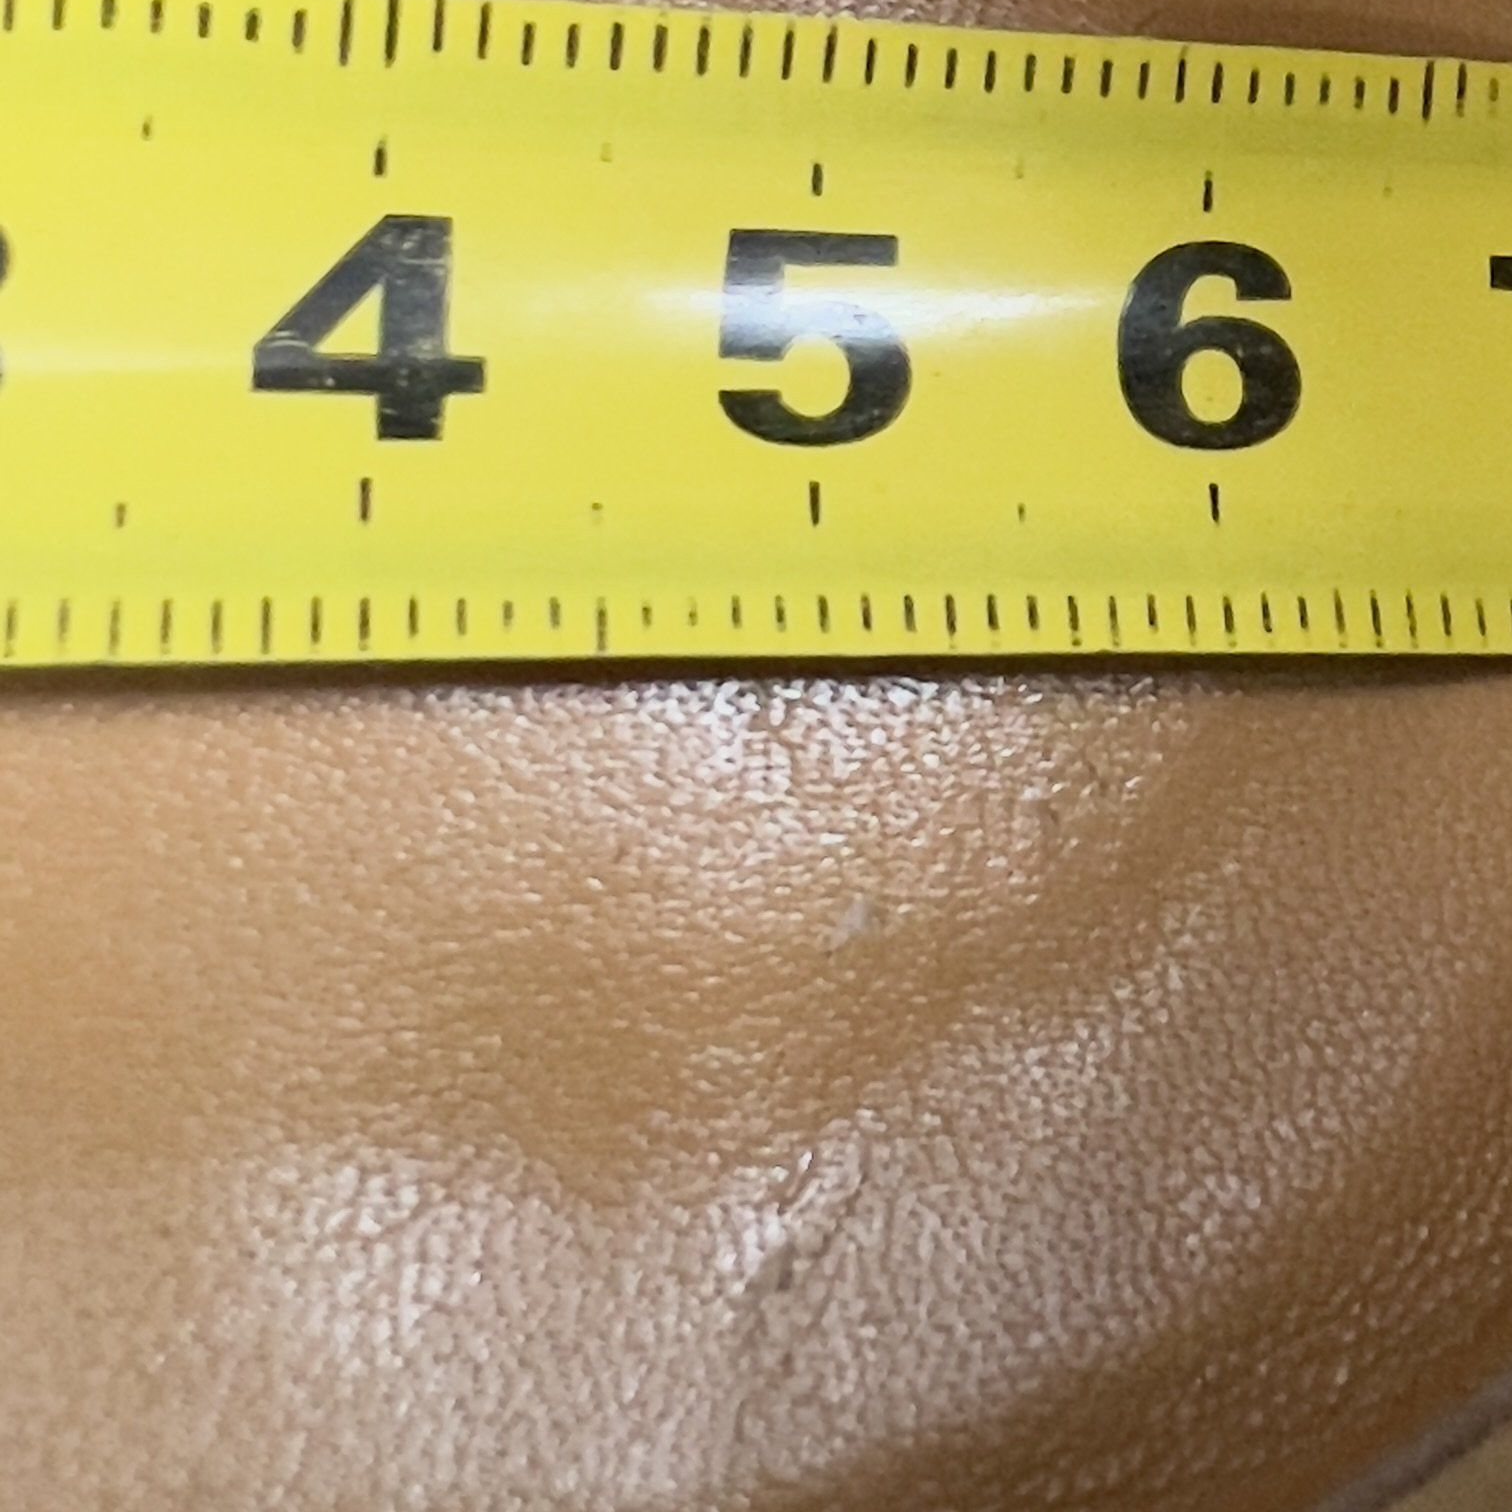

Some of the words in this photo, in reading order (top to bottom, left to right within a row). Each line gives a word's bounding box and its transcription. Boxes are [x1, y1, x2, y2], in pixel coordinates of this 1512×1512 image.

[253, 214, 485, 441] 4
[718, 229, 911, 447] 5
[1117, 240, 1302, 451] 6
